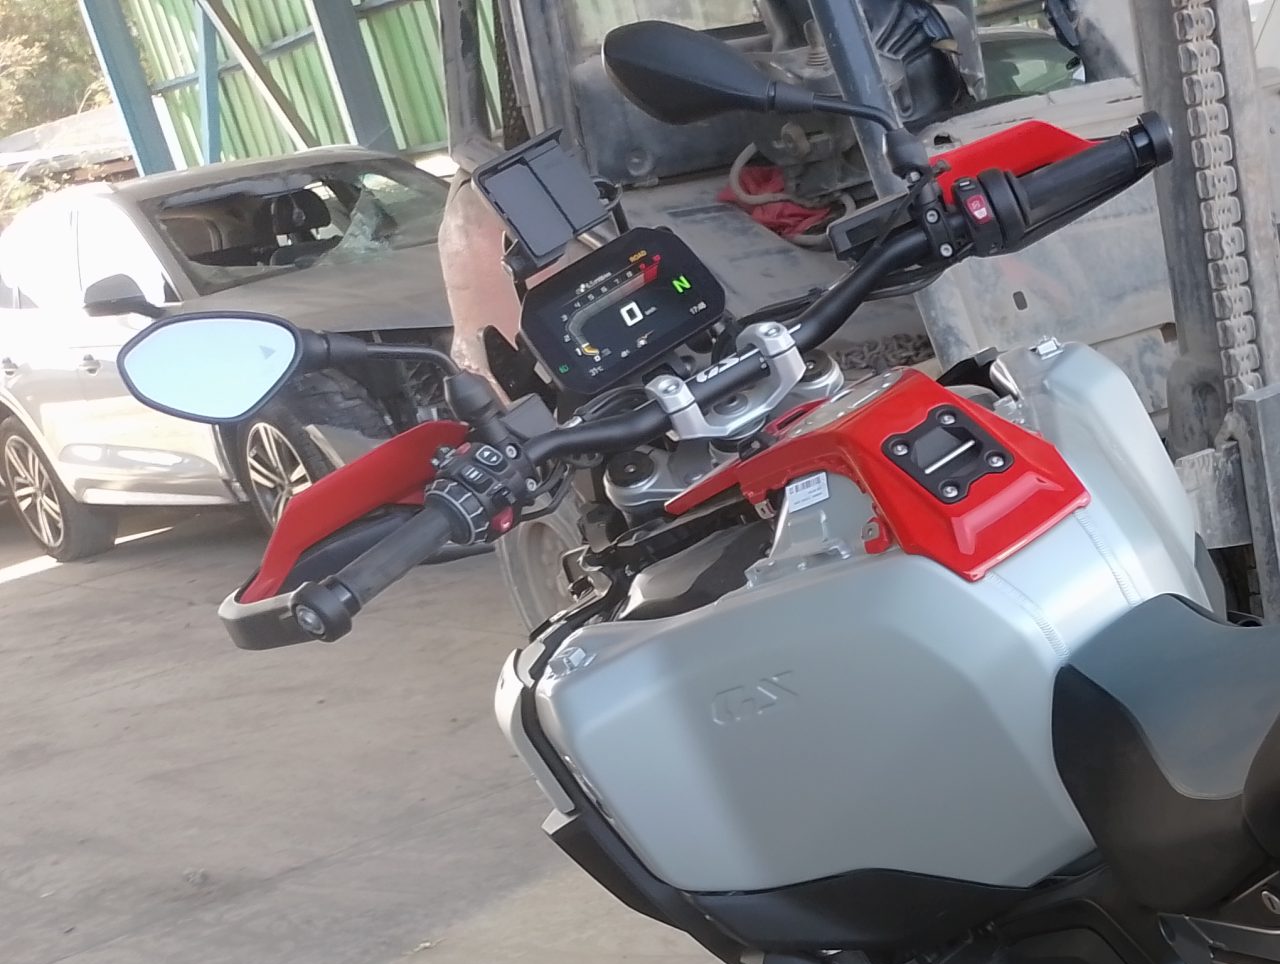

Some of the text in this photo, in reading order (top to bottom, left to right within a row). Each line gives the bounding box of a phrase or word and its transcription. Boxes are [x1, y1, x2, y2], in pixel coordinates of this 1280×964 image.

[672, 275, 691, 293] N
[620, 301, 644, 327] 0
[711, 669, 799, 725] GS
